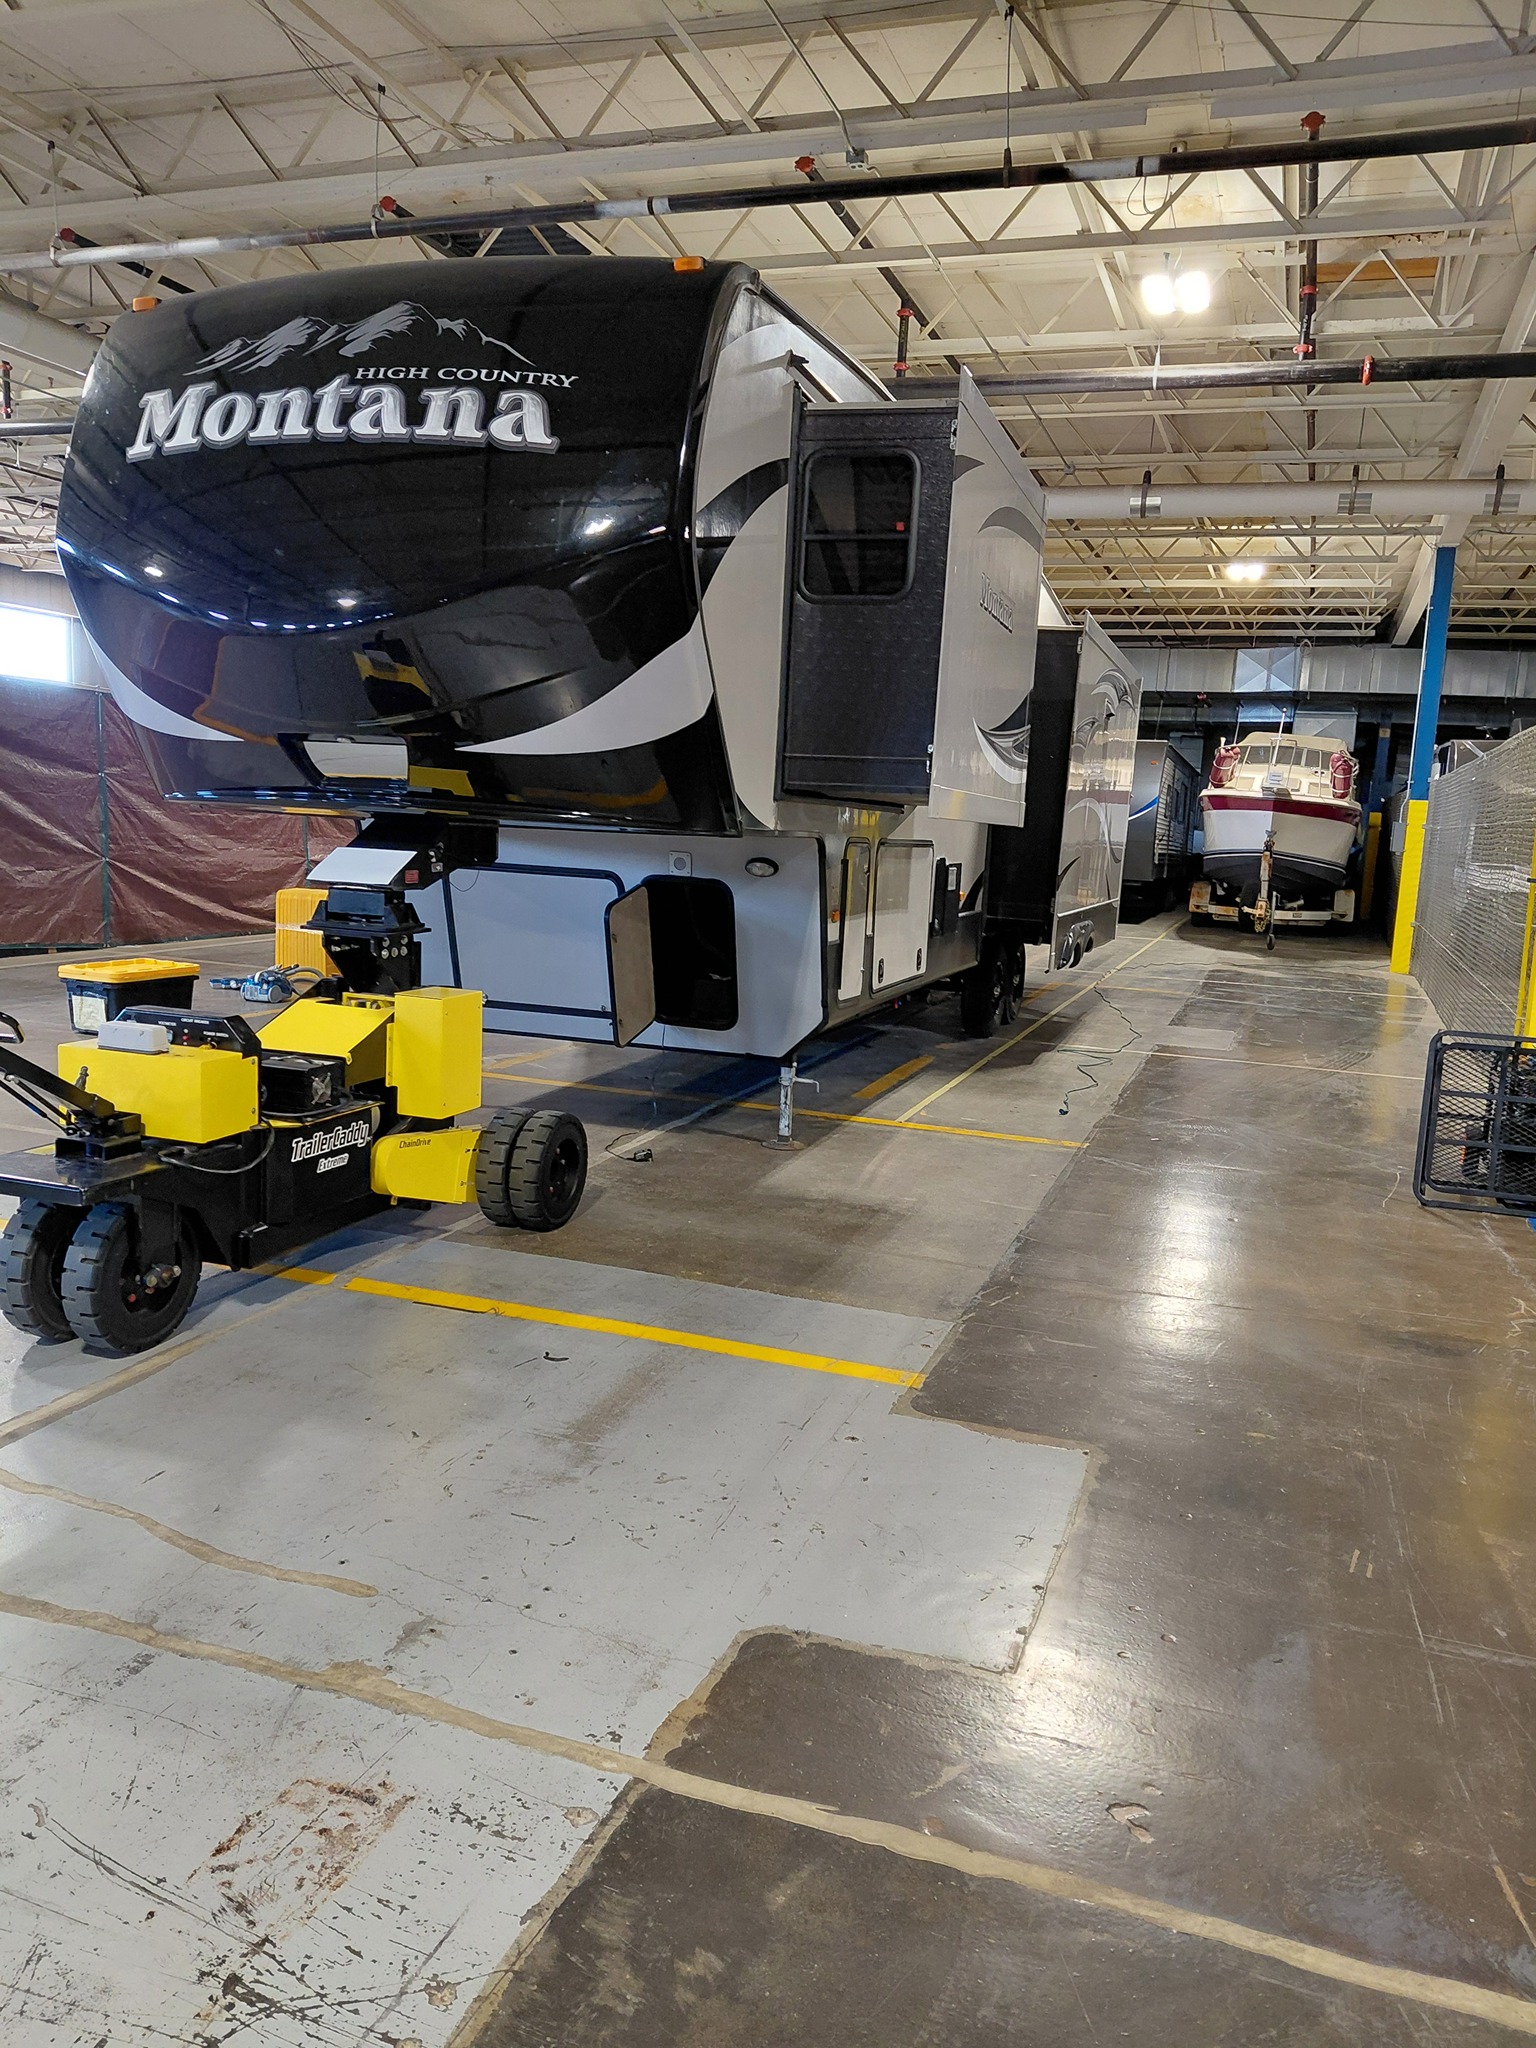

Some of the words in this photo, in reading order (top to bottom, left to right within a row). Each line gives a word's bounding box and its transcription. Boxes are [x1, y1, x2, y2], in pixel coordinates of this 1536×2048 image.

[355, 366, 429, 381] HIGH
[437, 367, 580, 389] COUNTRY
[126, 373, 560, 464] Montana
[291, 1120, 370, 1163] TrailerCaddy
[399, 1138, 432, 1149] ChainDrive
[316, 1153, 349, 1174] Extreme
